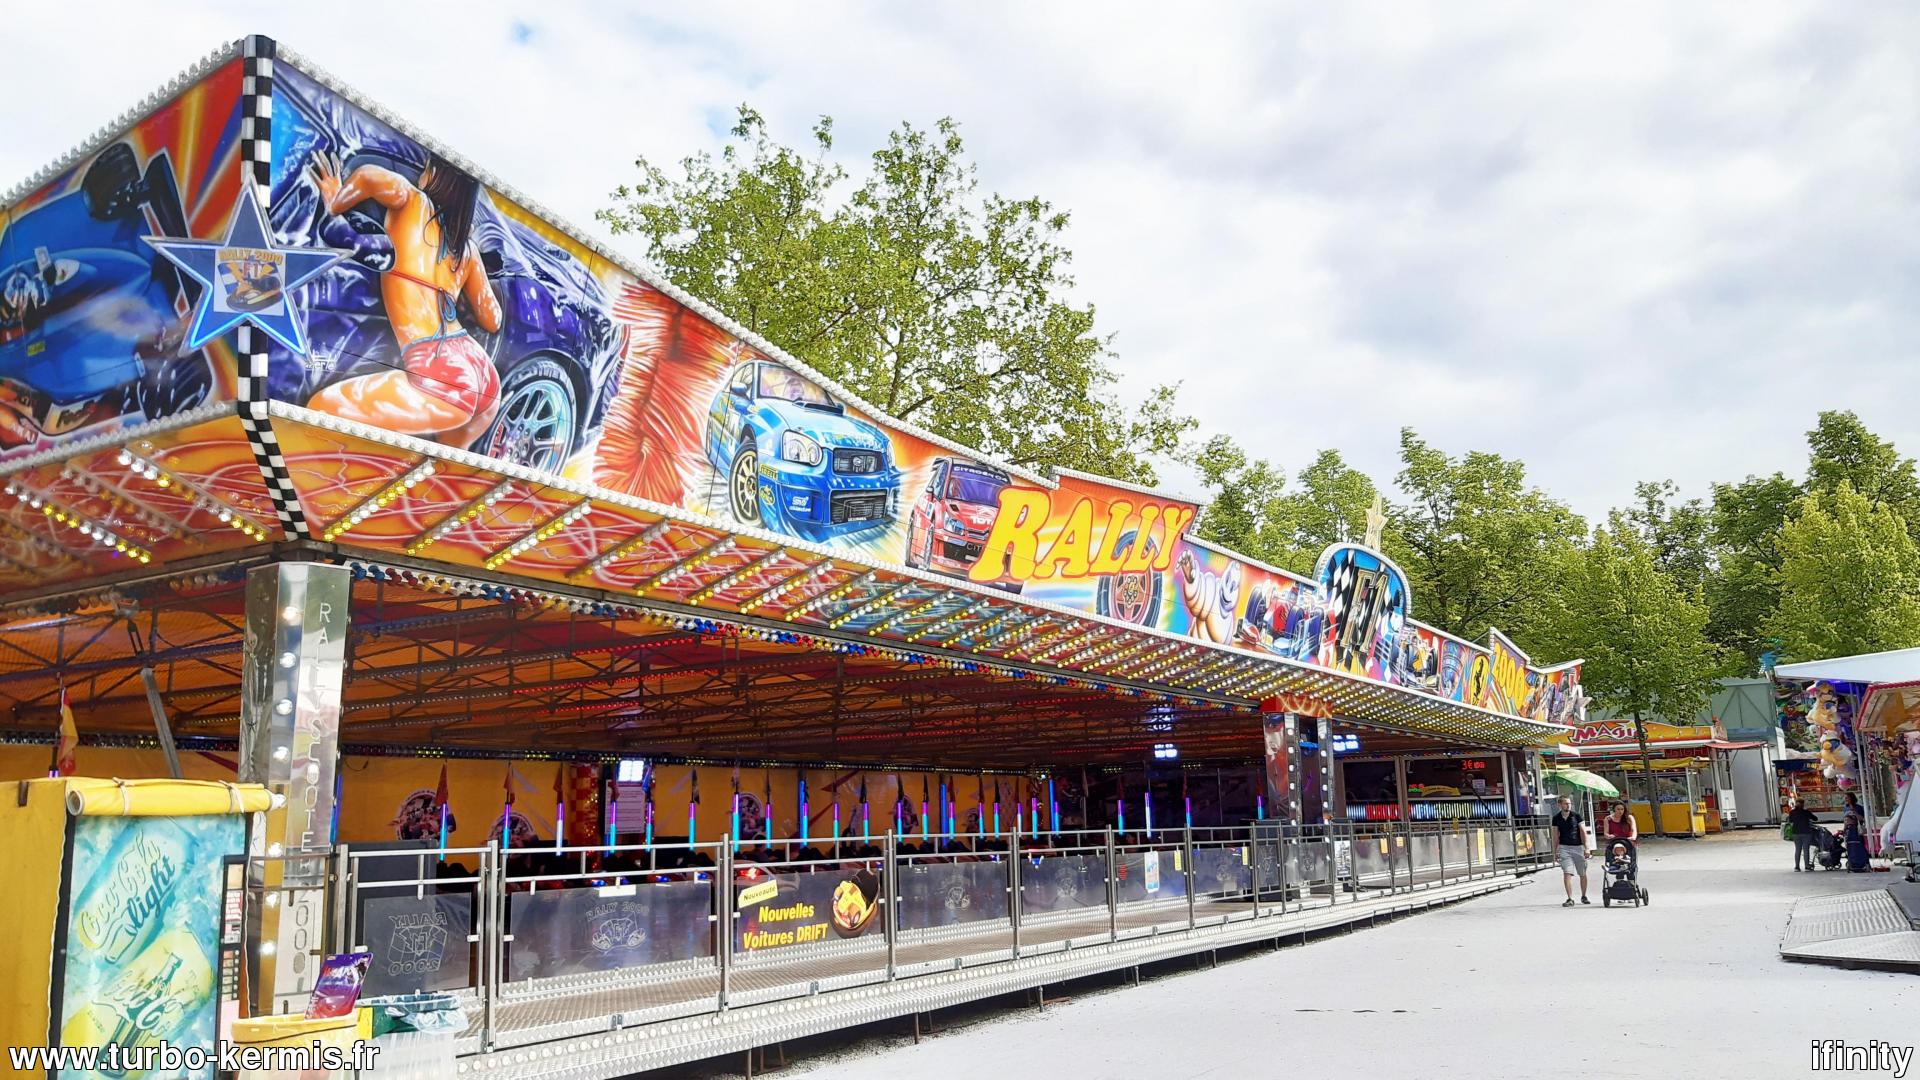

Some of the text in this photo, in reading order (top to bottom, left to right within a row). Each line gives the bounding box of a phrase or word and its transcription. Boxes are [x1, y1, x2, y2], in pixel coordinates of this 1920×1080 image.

[968, 484, 1193, 582] RALLY
[1339, 570, 1389, 653] F1
[1492, 640, 1525, 711] 2000
[1570, 722, 1648, 743] MAGI
[127, 853, 176, 928] light
[758, 903, 815, 923] Nouvelles
[743, 923, 829, 949] Voitures DRIFT
